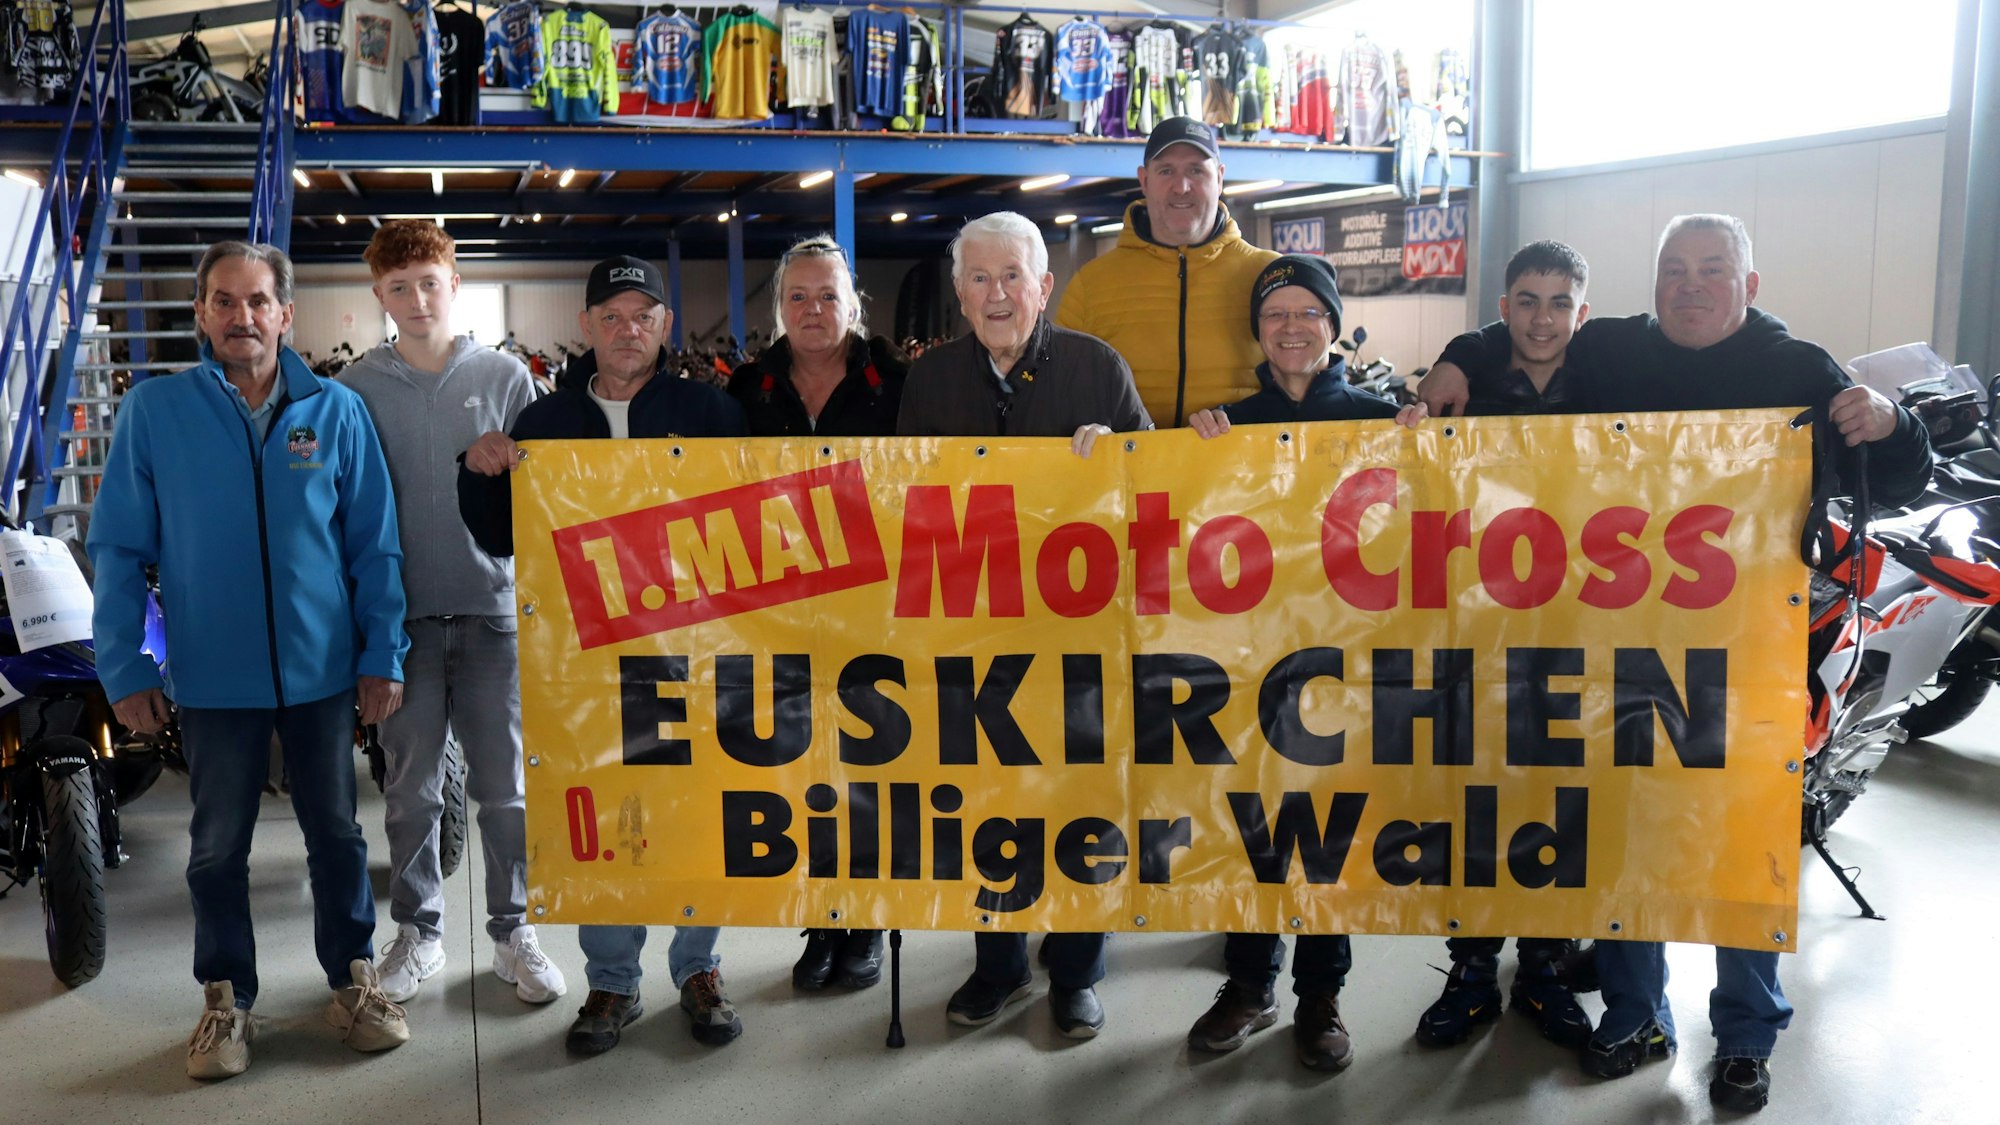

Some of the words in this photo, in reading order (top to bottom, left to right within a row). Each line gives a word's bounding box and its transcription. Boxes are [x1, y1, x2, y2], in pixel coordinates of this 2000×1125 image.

[657, 33, 681, 54] 12
[1205, 52, 1229, 80] 33
[1341, 210, 1387, 232] MOTORÖLE
[1343, 231, 1383, 250] ADDITIVE
[1326, 247, 1402, 266] MOTORRADPFLEGE
[610, 266, 645, 280] FXR
[894, 484, 1274, 618] Moto
[1321, 467, 1737, 611] Cross
[619, 646, 1728, 768] EUSKIRCHEN
[49, 756, 87, 767] YAMAHA
[722, 782, 1192, 912] Billiger
[1226, 785, 1589, 889] Wald
